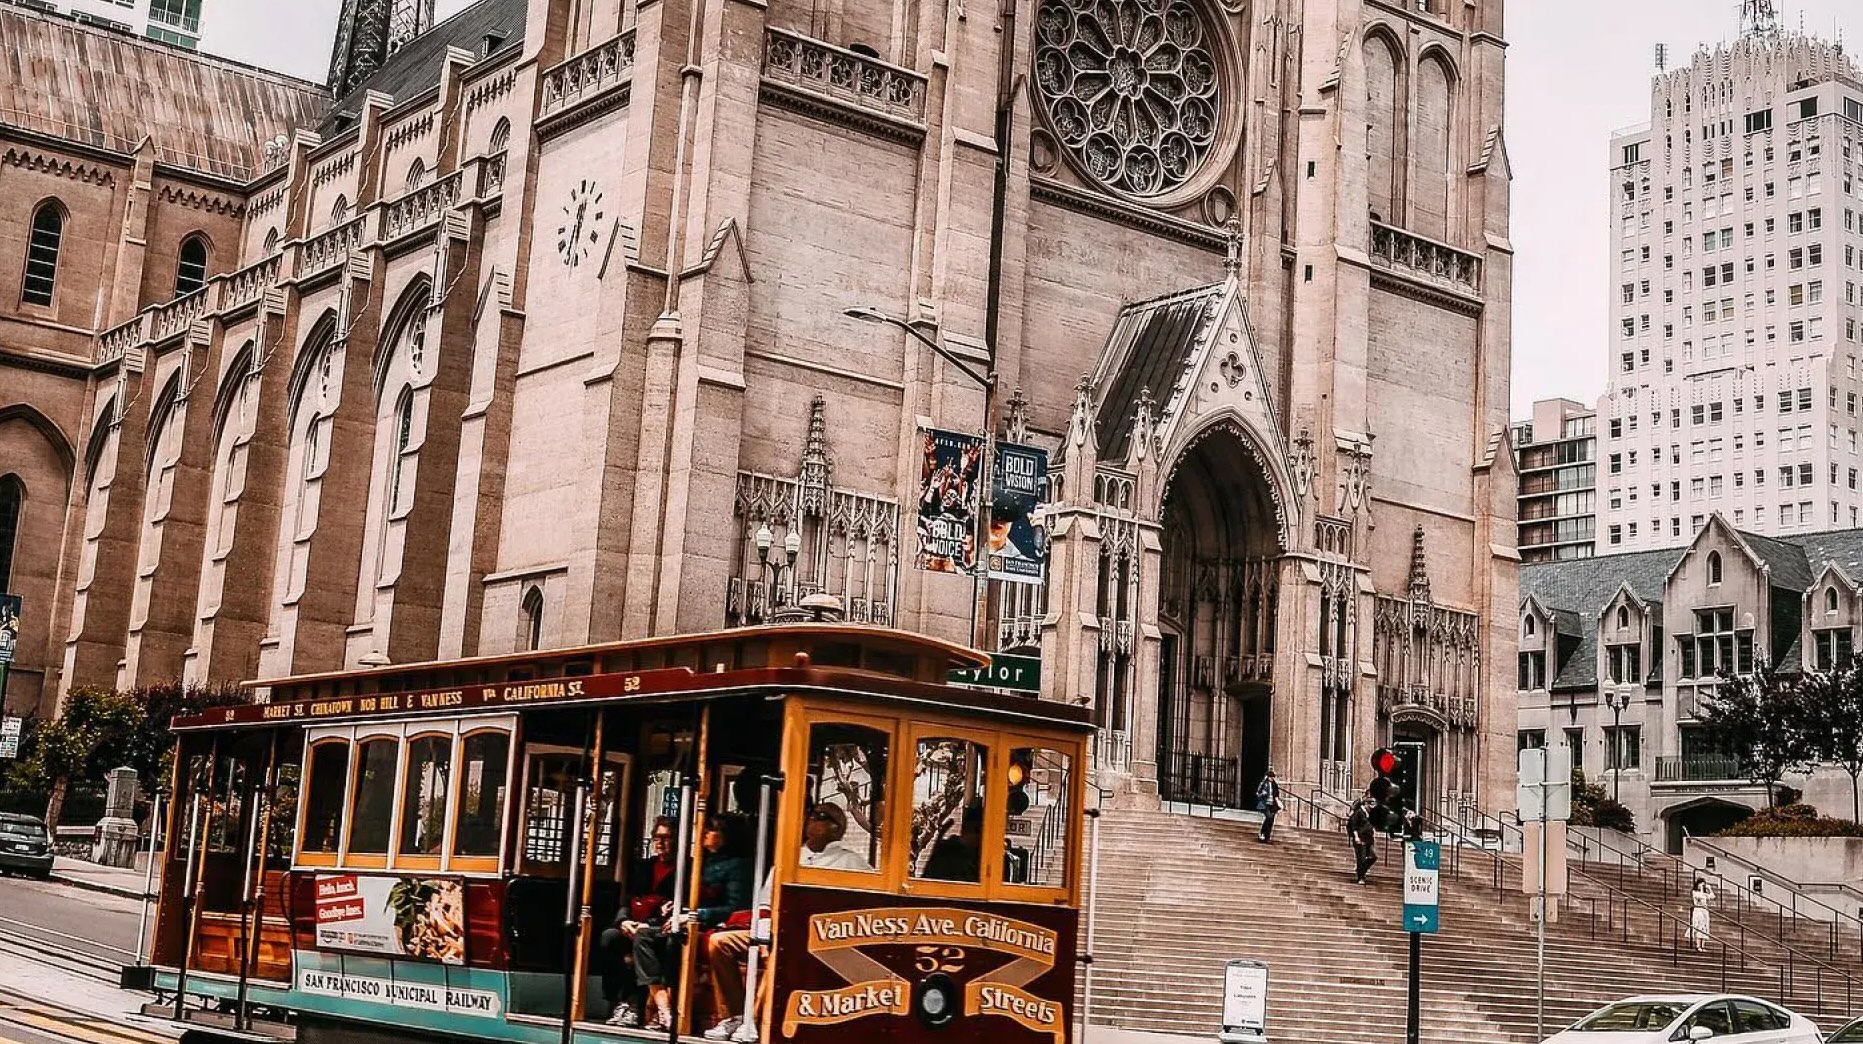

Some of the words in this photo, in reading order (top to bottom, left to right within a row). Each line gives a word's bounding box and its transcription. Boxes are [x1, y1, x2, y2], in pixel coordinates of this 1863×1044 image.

[1005, 455, 1034, 476] BOLD
[1005, 474, 1034, 491] VISION
[932, 520, 963, 541] BOLD
[932, 538, 962, 557] VOICE
[957, 664, 1023, 681] ylor
[263, 704, 291, 719] MARKET
[310, 700, 352, 716] CHINATOWN
[360, 697, 376, 712] NOB
[380, 696, 399, 710] HILL
[504, 683, 566, 701] CALIFORNIA
[624, 676, 641, 692] 52
[1423, 848, 1434, 858] 49
[1409, 876, 1433, 885] SCENIC
[1410, 884, 1431, 893] DRIVE
[964, 915, 1056, 955] California
[915, 946, 966, 974] 52
[305, 974, 324, 988] SAN
[326, 976, 380, 997] FRANCISCO
[385, 984, 439, 1005] MUNICIPAL
[446, 991, 492, 1011] RAILWAY
[798, 993, 815, 1016] &
[820, 984, 902, 1016] Market
[980, 986, 1057, 1024] Streets
